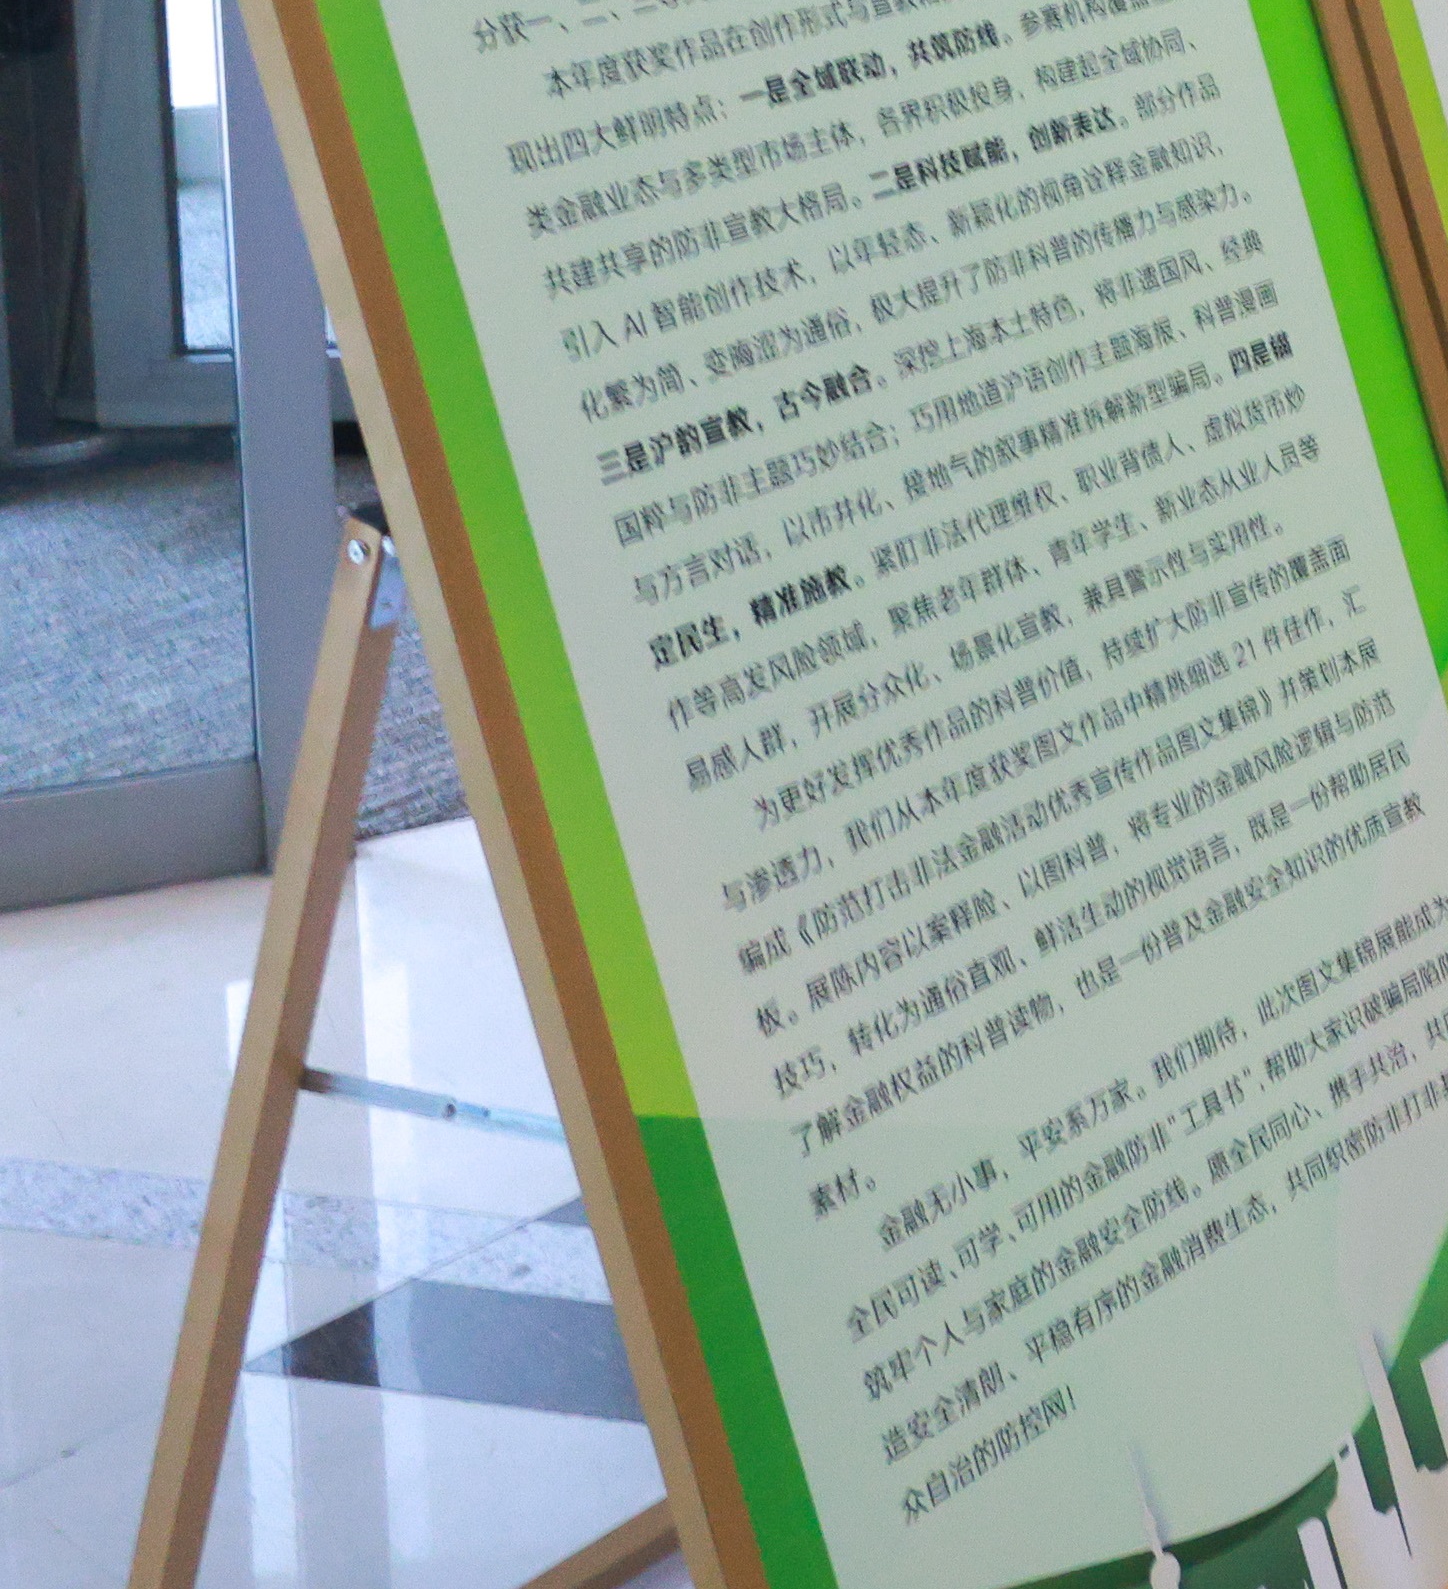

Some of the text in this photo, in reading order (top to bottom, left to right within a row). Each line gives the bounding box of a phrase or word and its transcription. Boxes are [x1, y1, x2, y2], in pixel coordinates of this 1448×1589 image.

[807, 1165, 877, 1220] 素材。
[896, 1380, 1082, 1530] 众自治的防控网！
